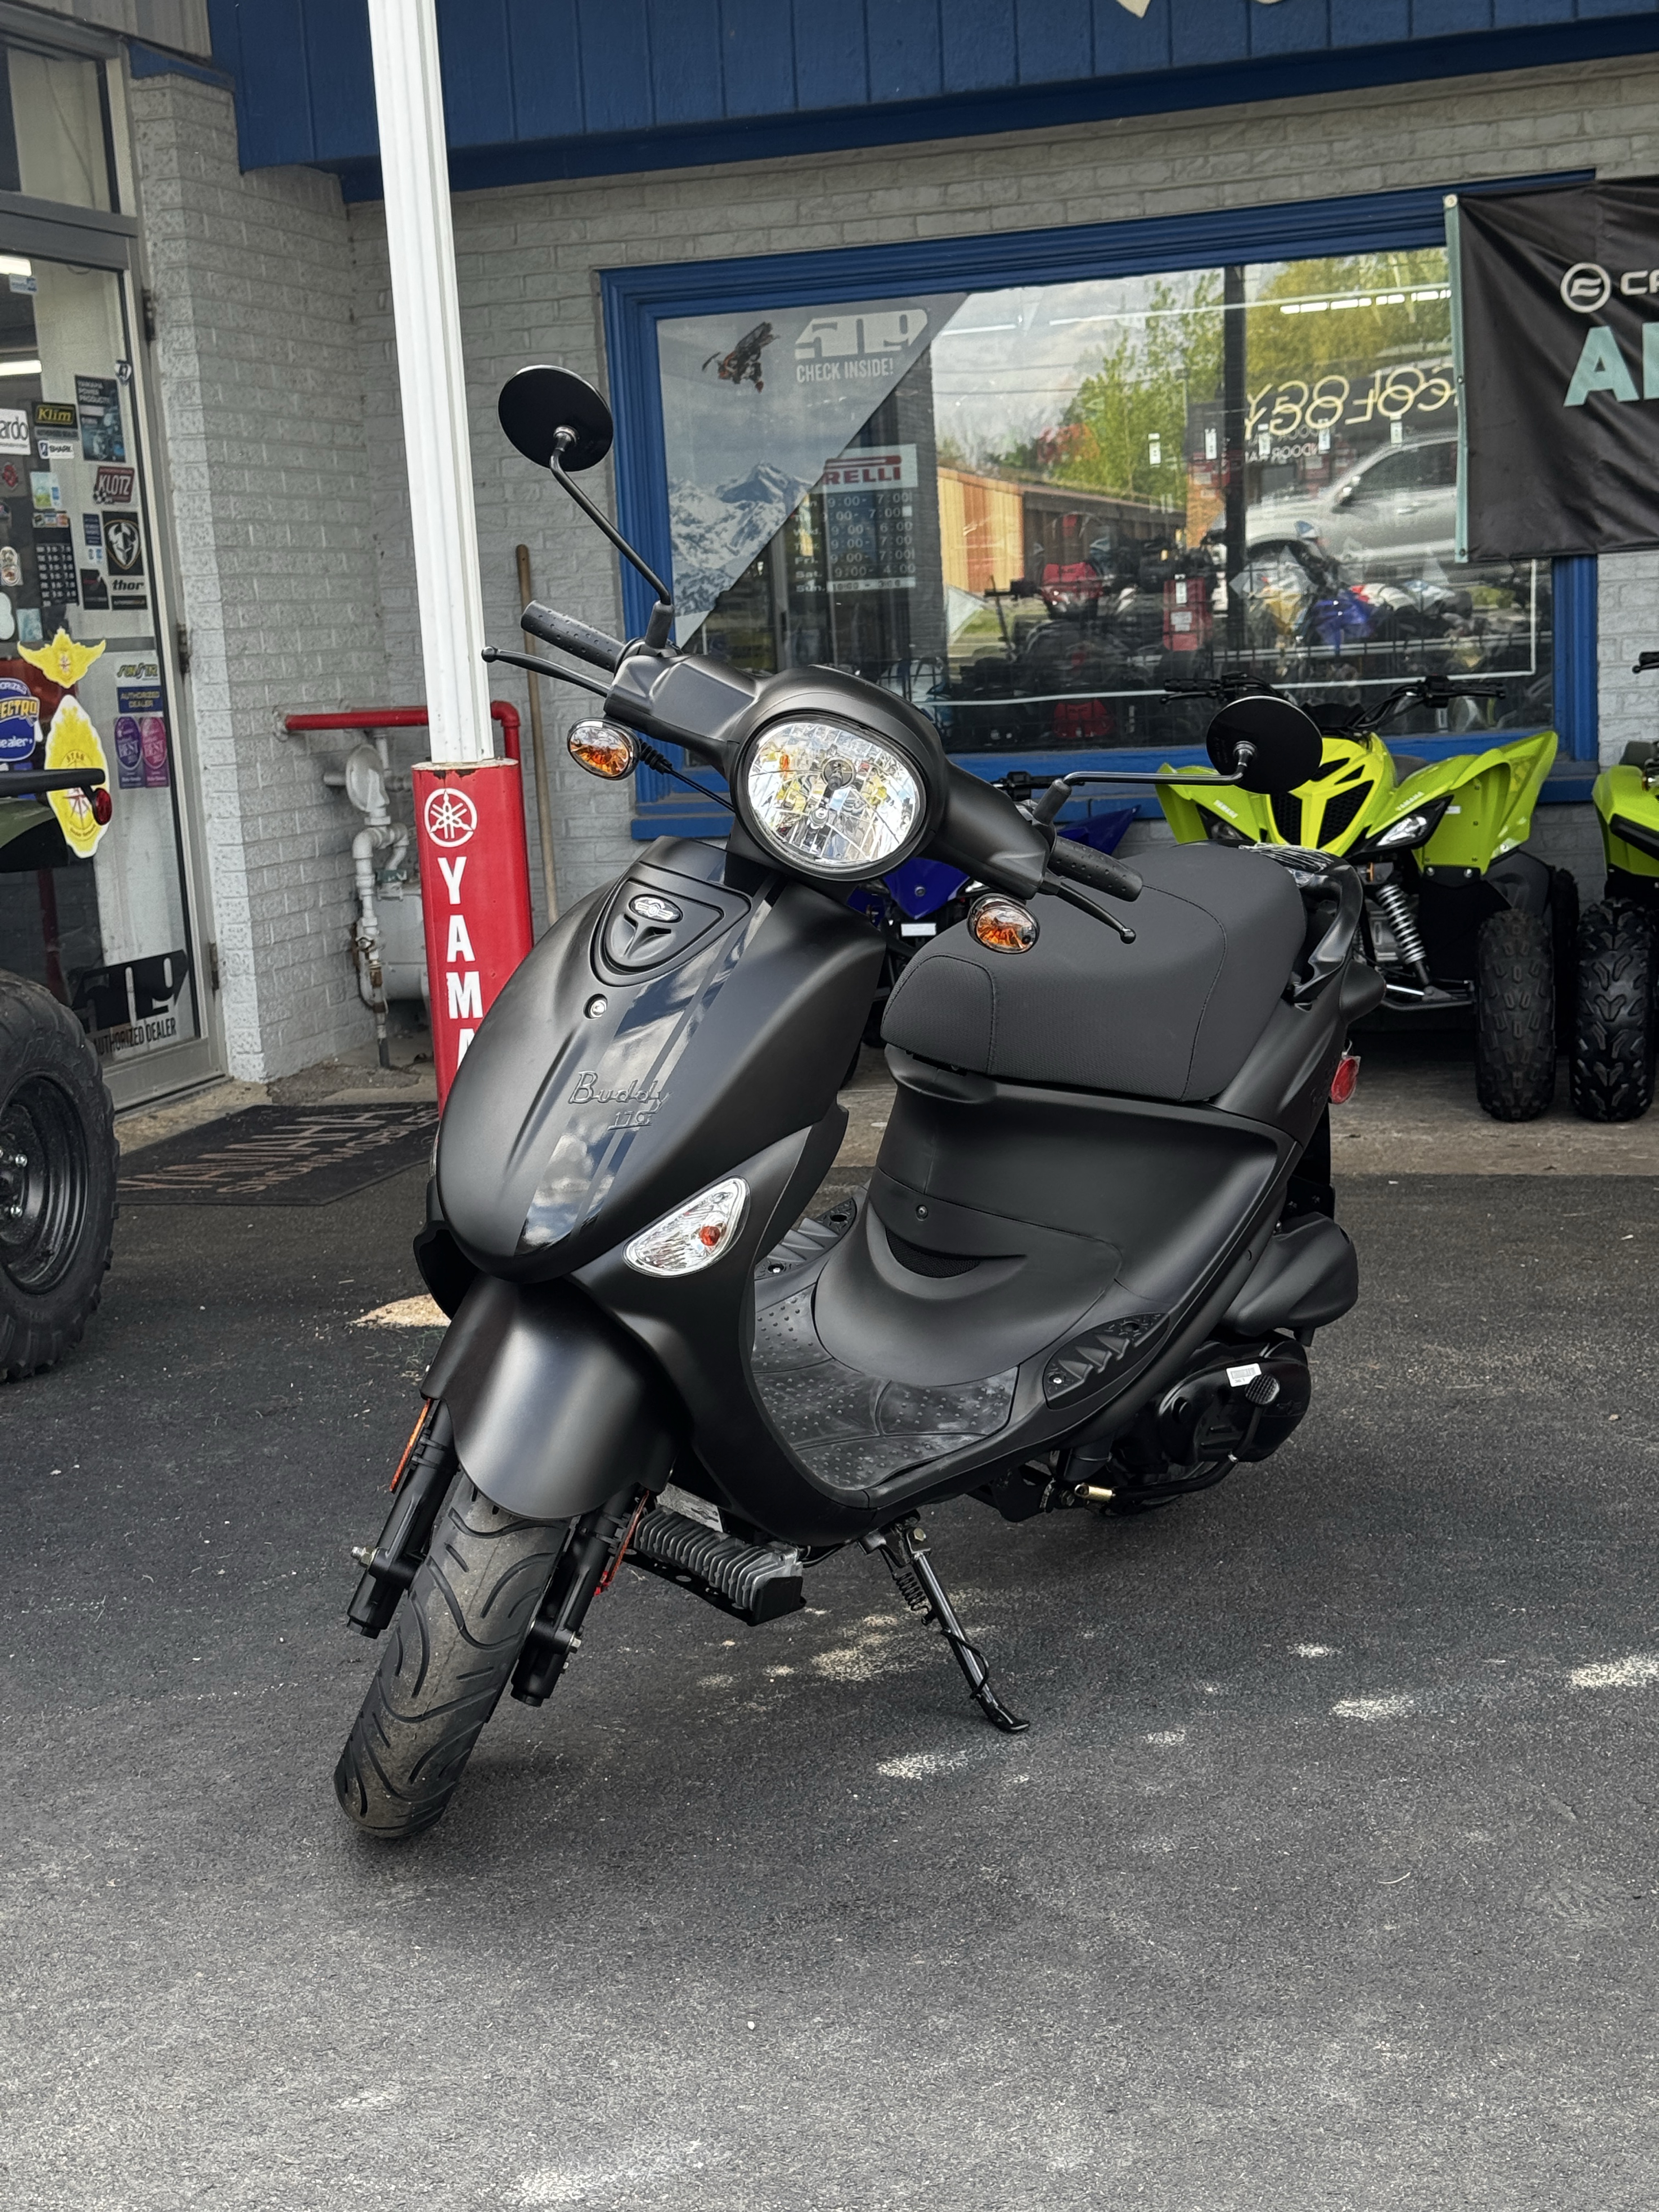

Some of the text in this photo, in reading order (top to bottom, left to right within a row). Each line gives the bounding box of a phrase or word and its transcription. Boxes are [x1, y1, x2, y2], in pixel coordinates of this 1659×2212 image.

[796, 358, 894, 383] CHECK INSIDE!
[98, 474, 131, 496] KLOTZ
[113, 579, 144, 590] thor
[0, 700, 37, 718] ECTRO
[145, 1017, 177, 1043] DEALER
[567, 1070, 674, 1114] Buddy
